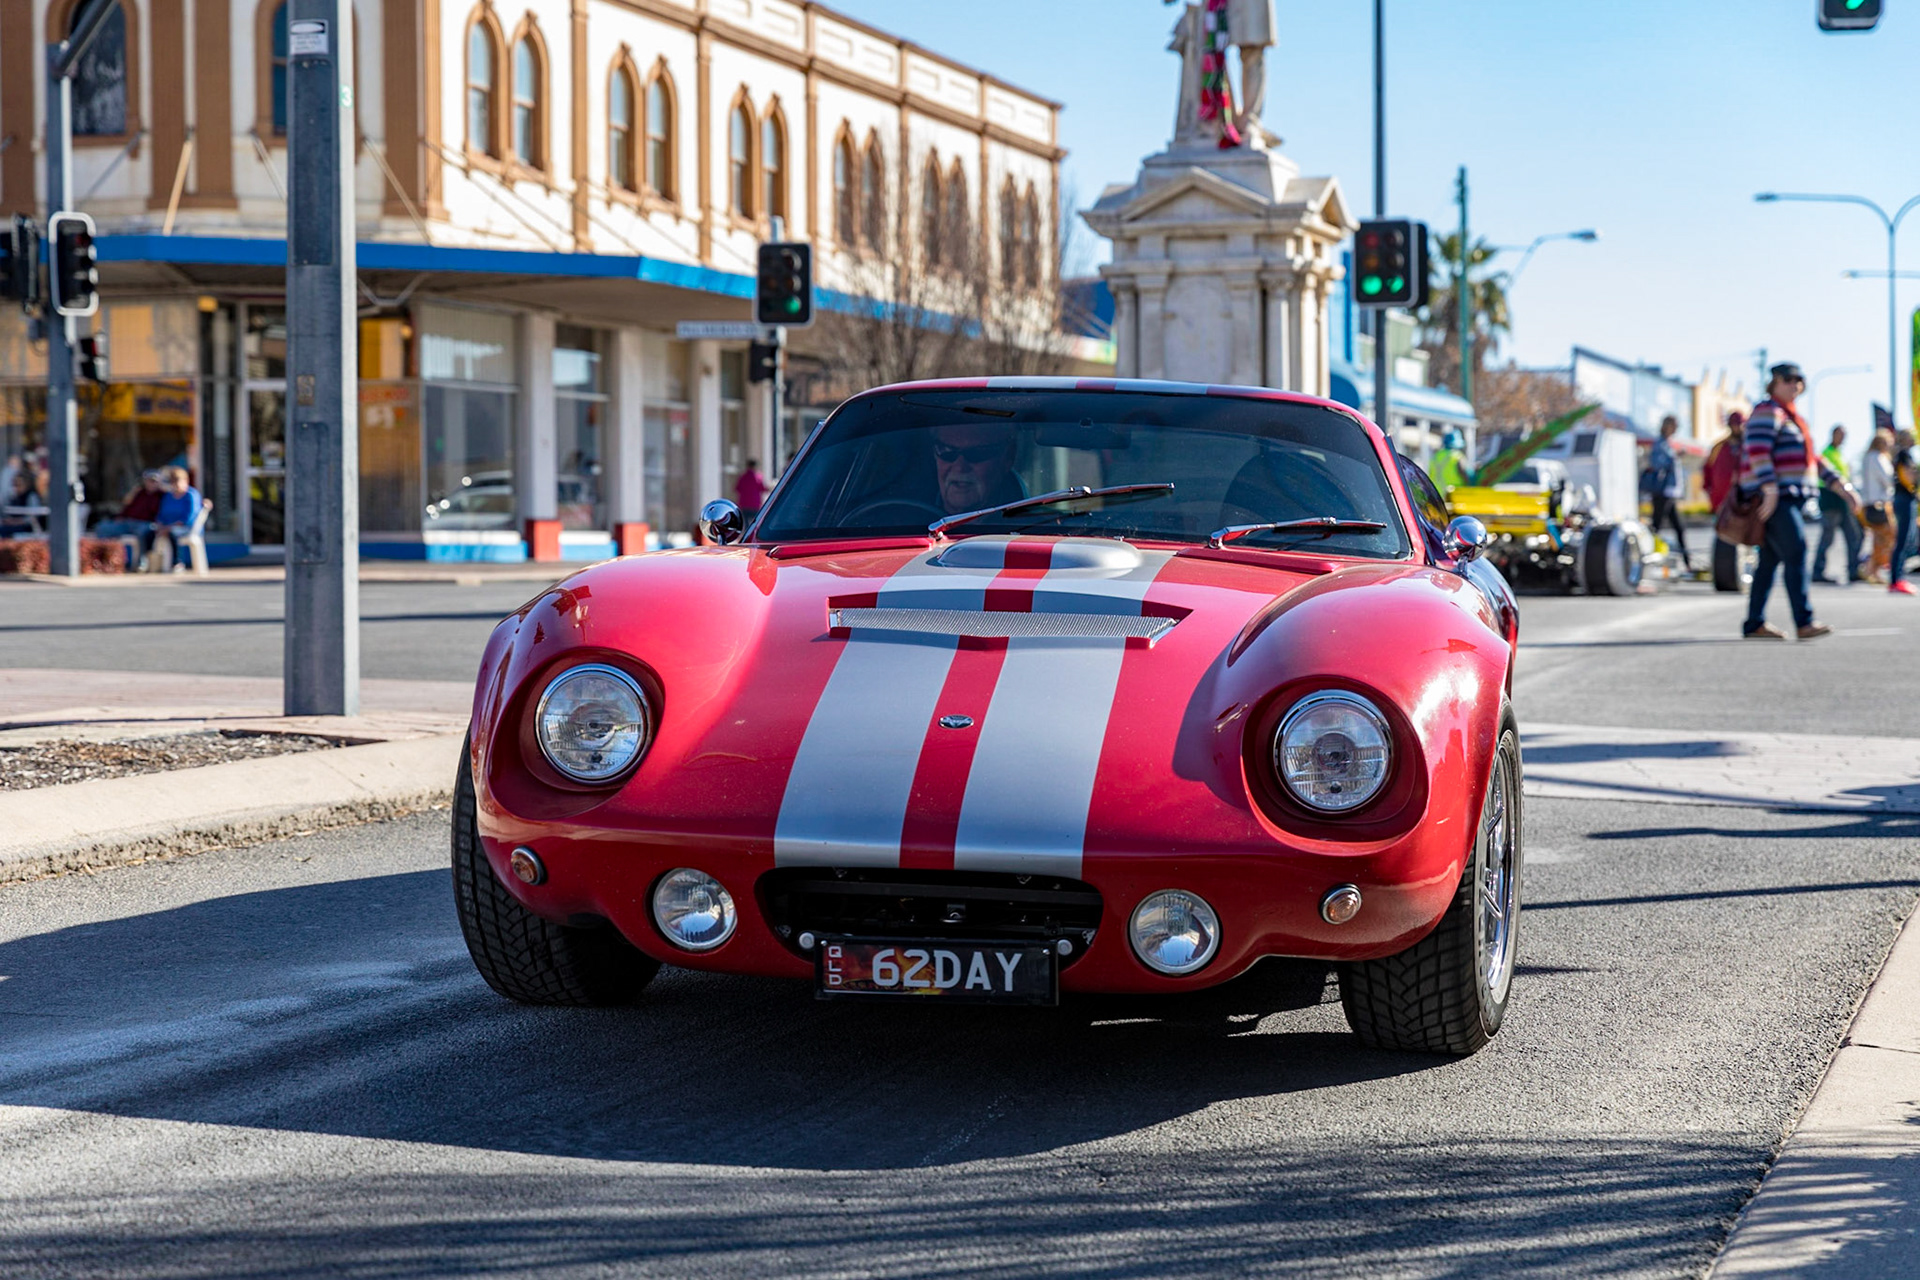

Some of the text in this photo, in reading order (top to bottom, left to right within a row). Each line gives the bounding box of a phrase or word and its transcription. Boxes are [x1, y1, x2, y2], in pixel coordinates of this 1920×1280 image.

[341, 86, 352, 107] 3
[828, 946, 842, 985] QLD
[872, 948, 1022, 992] 62DAY
